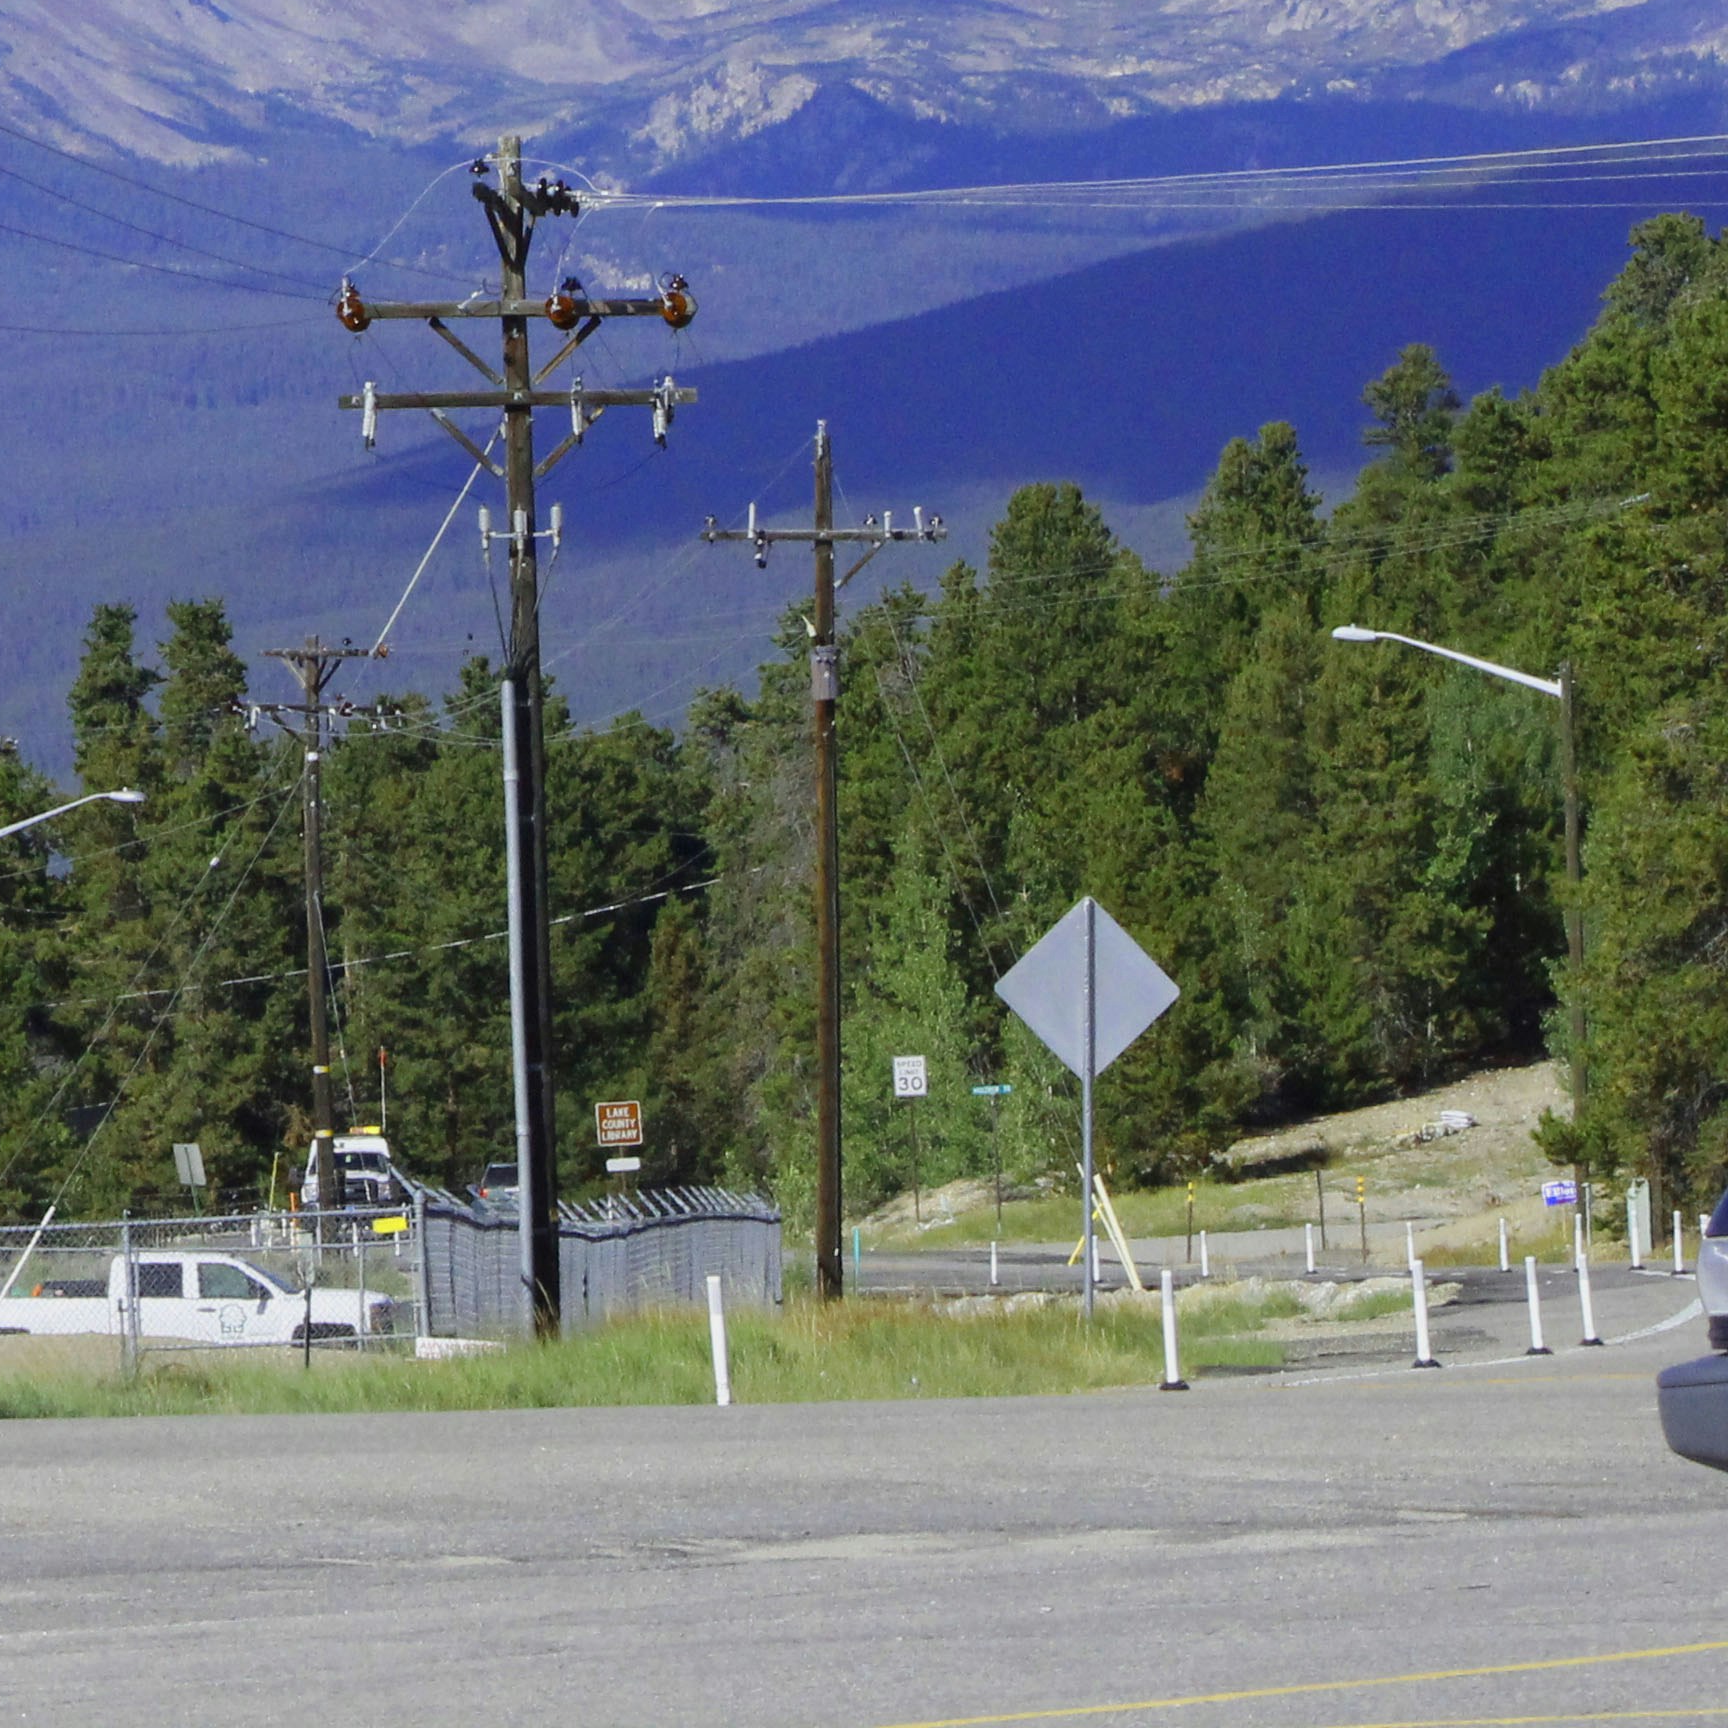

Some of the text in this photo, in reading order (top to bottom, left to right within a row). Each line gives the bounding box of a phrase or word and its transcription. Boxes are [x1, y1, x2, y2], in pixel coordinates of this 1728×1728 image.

[897, 1060, 922, 1068] SPEED
[898, 1076, 923, 1091] 30
[606, 1106, 630, 1118] LAKE
[601, 1118, 637, 1130] COUNTY
[601, 1129, 638, 1141] LIBRARY
